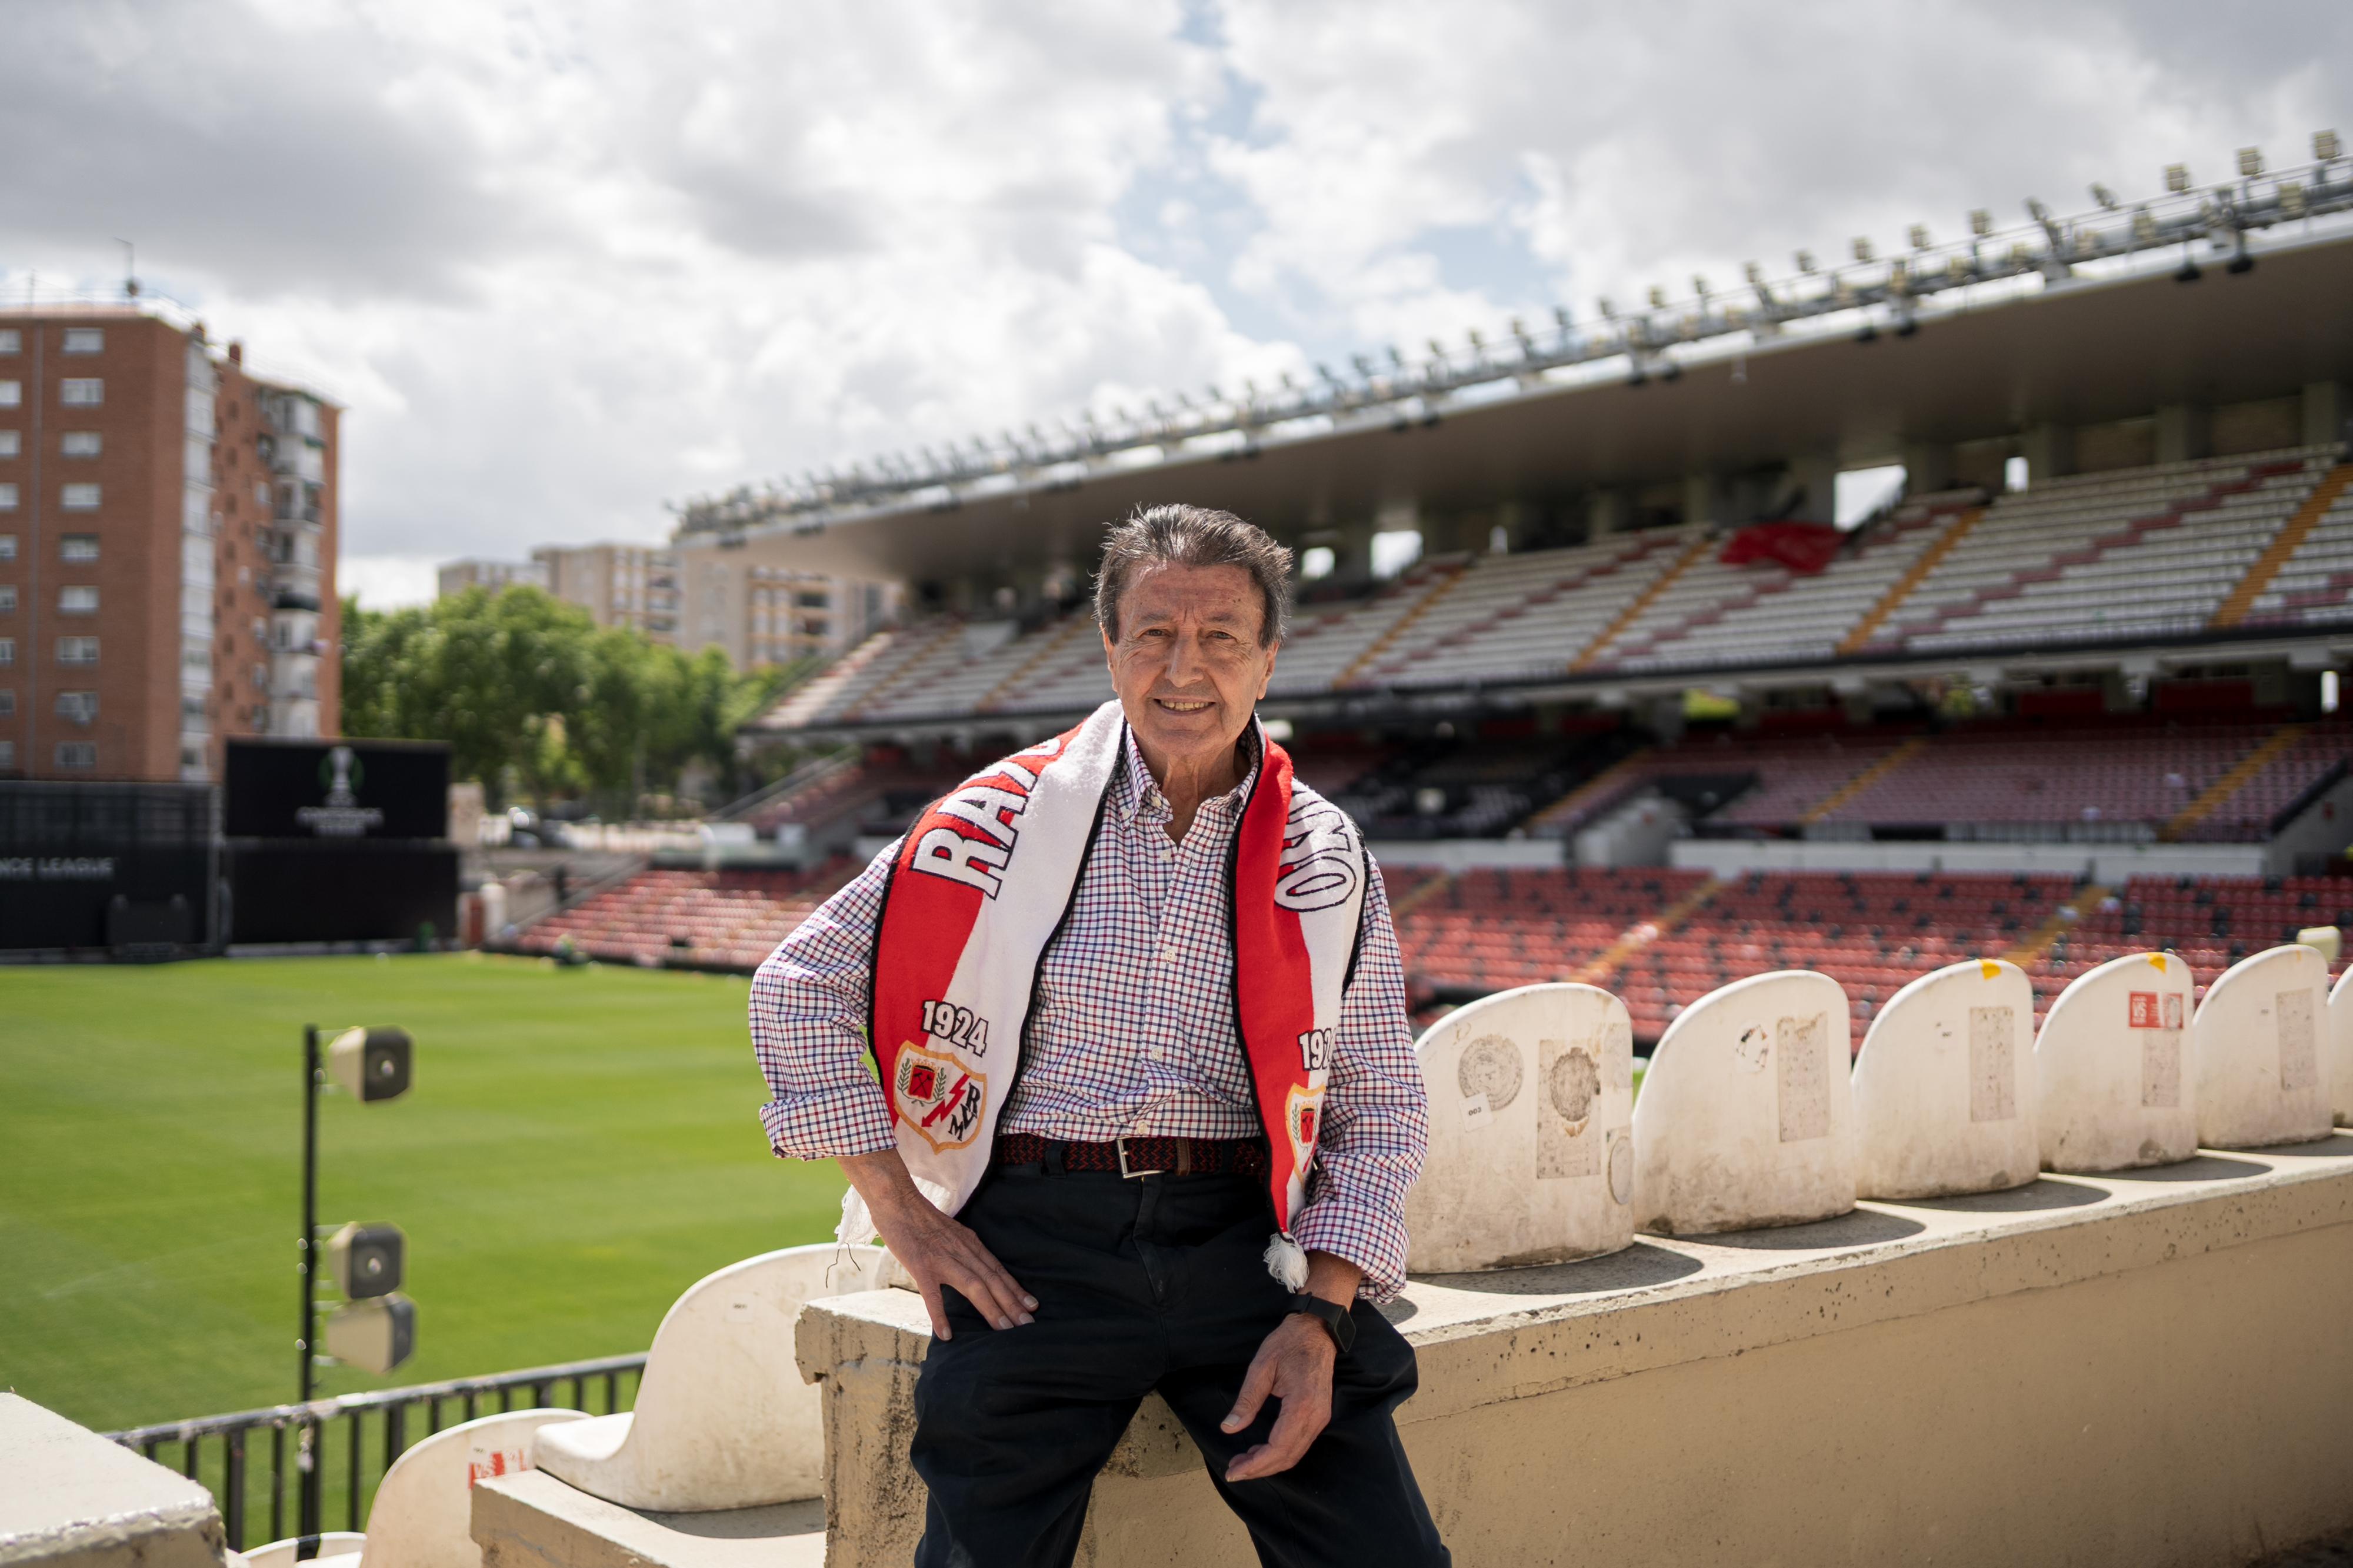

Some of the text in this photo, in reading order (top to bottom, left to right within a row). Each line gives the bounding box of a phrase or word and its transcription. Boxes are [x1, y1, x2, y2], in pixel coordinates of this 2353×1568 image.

[37, 857, 114, 879] LEAGUE
[921, 1000, 988, 1057] 1924
[1298, 1027, 1335, 1070] 192
[1468, 1107, 1482, 1116] 003
